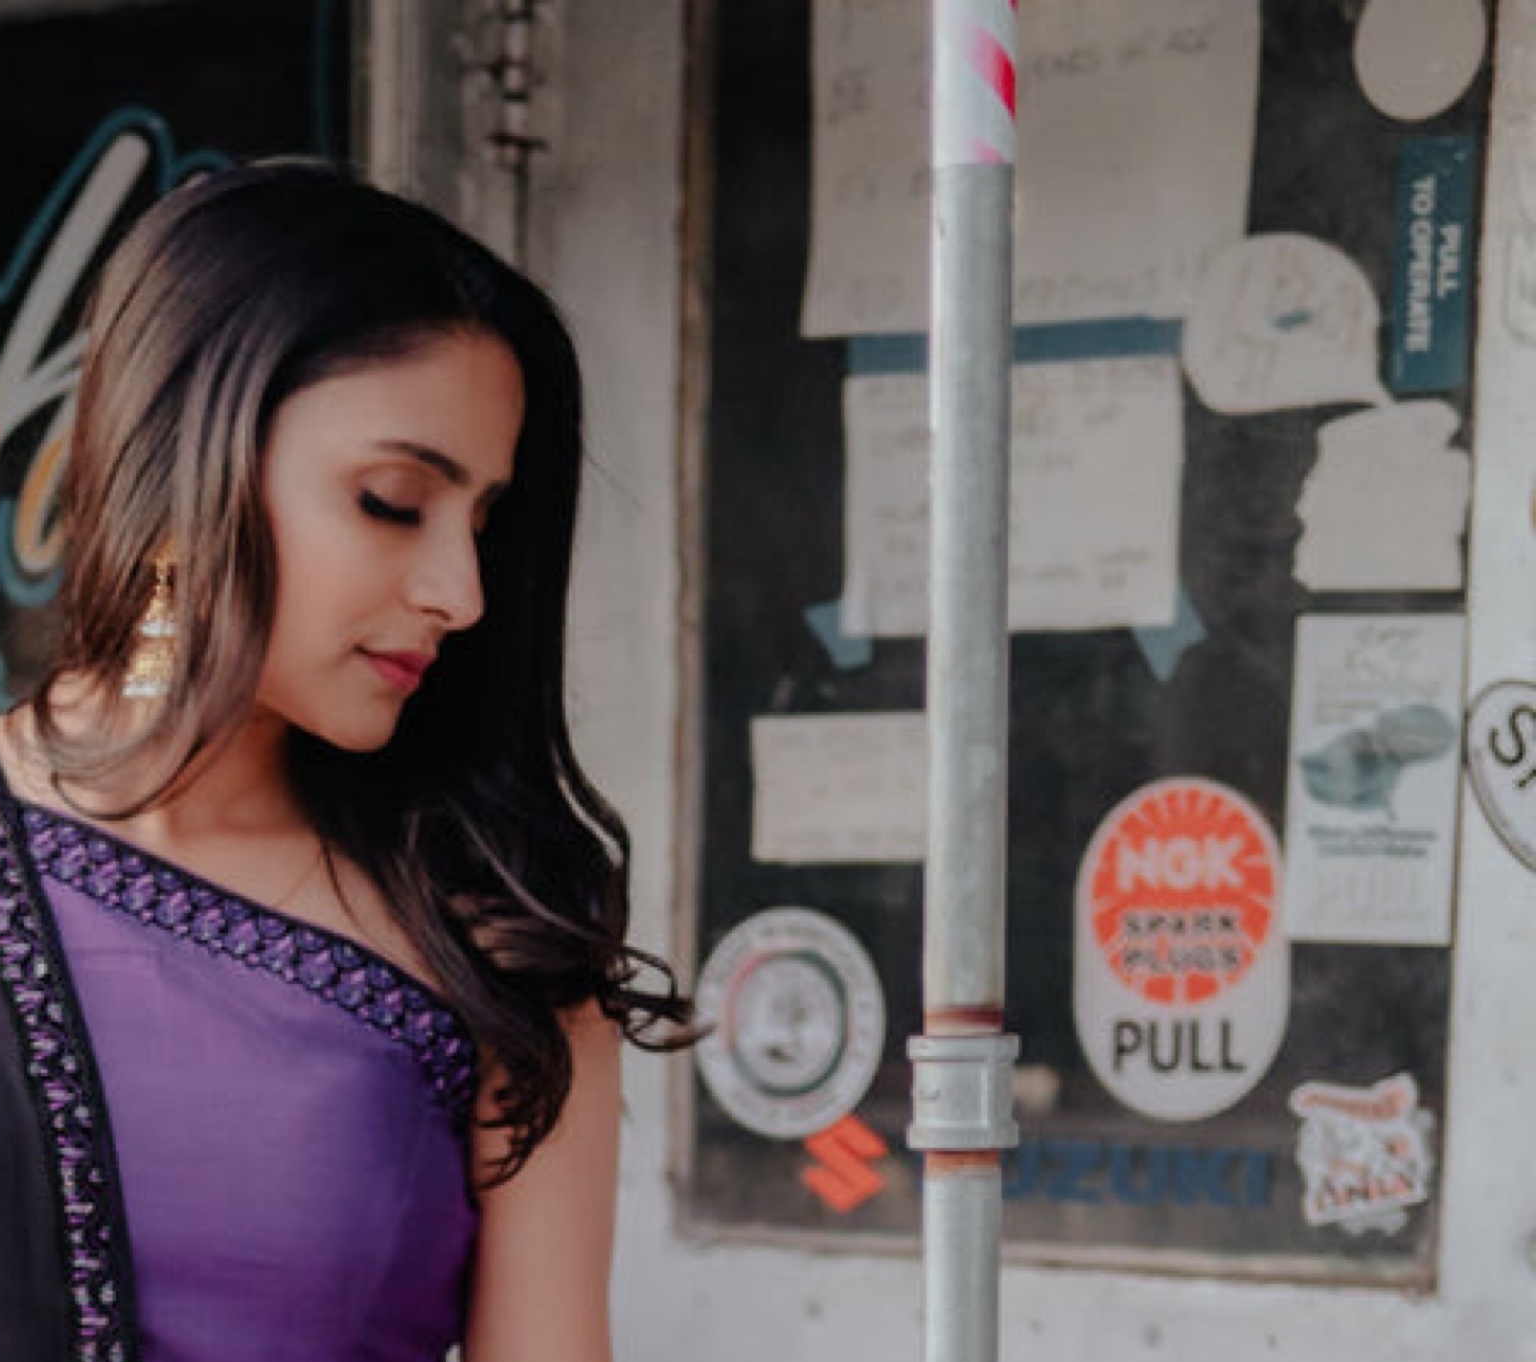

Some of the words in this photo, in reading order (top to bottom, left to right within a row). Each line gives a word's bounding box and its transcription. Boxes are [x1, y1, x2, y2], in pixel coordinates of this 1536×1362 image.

[1409, 174, 1437, 216] TO
[1404, 218, 1434, 352] OPERATE
[1117, 837, 1244, 890] NGK
[1123, 911, 1238, 936] SPARK
[1122, 945, 1241, 974] PLUGS
[1113, 1019, 1246, 1073] PULL
[1002, 1142, 1274, 1207] ZUKI
